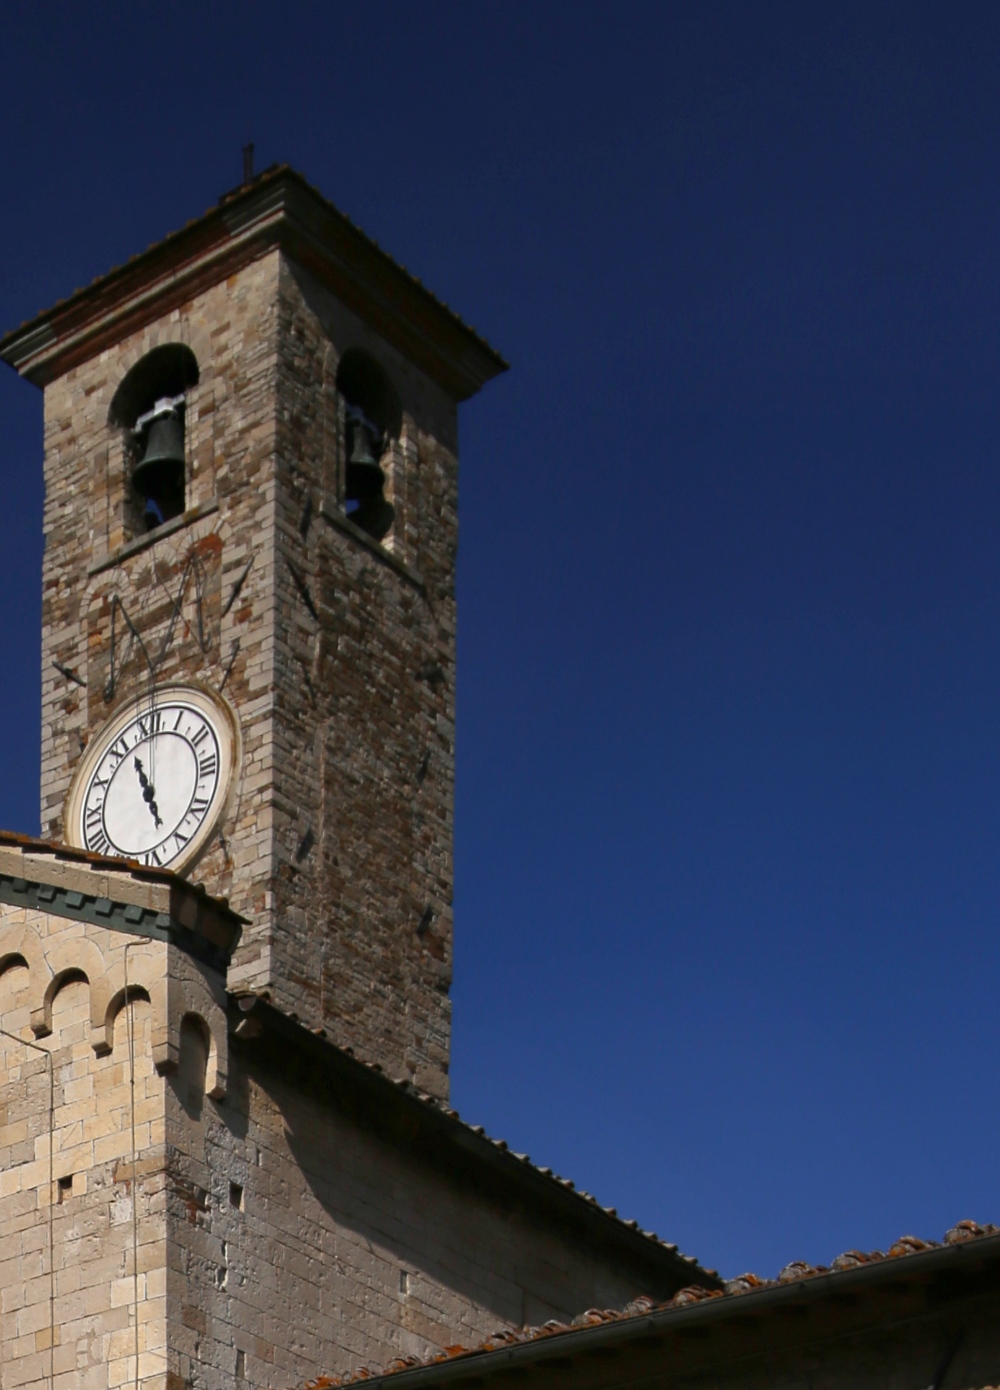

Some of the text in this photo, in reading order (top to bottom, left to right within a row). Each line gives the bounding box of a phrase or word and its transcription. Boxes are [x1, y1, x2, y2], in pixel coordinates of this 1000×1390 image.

[138, 712, 161, 741] XII
[191, 725, 209, 747] II
[110, 737, 130, 764] XI
[200, 753, 216, 778] III
[93, 772, 109, 791] X
[174, 832, 188, 850] V
